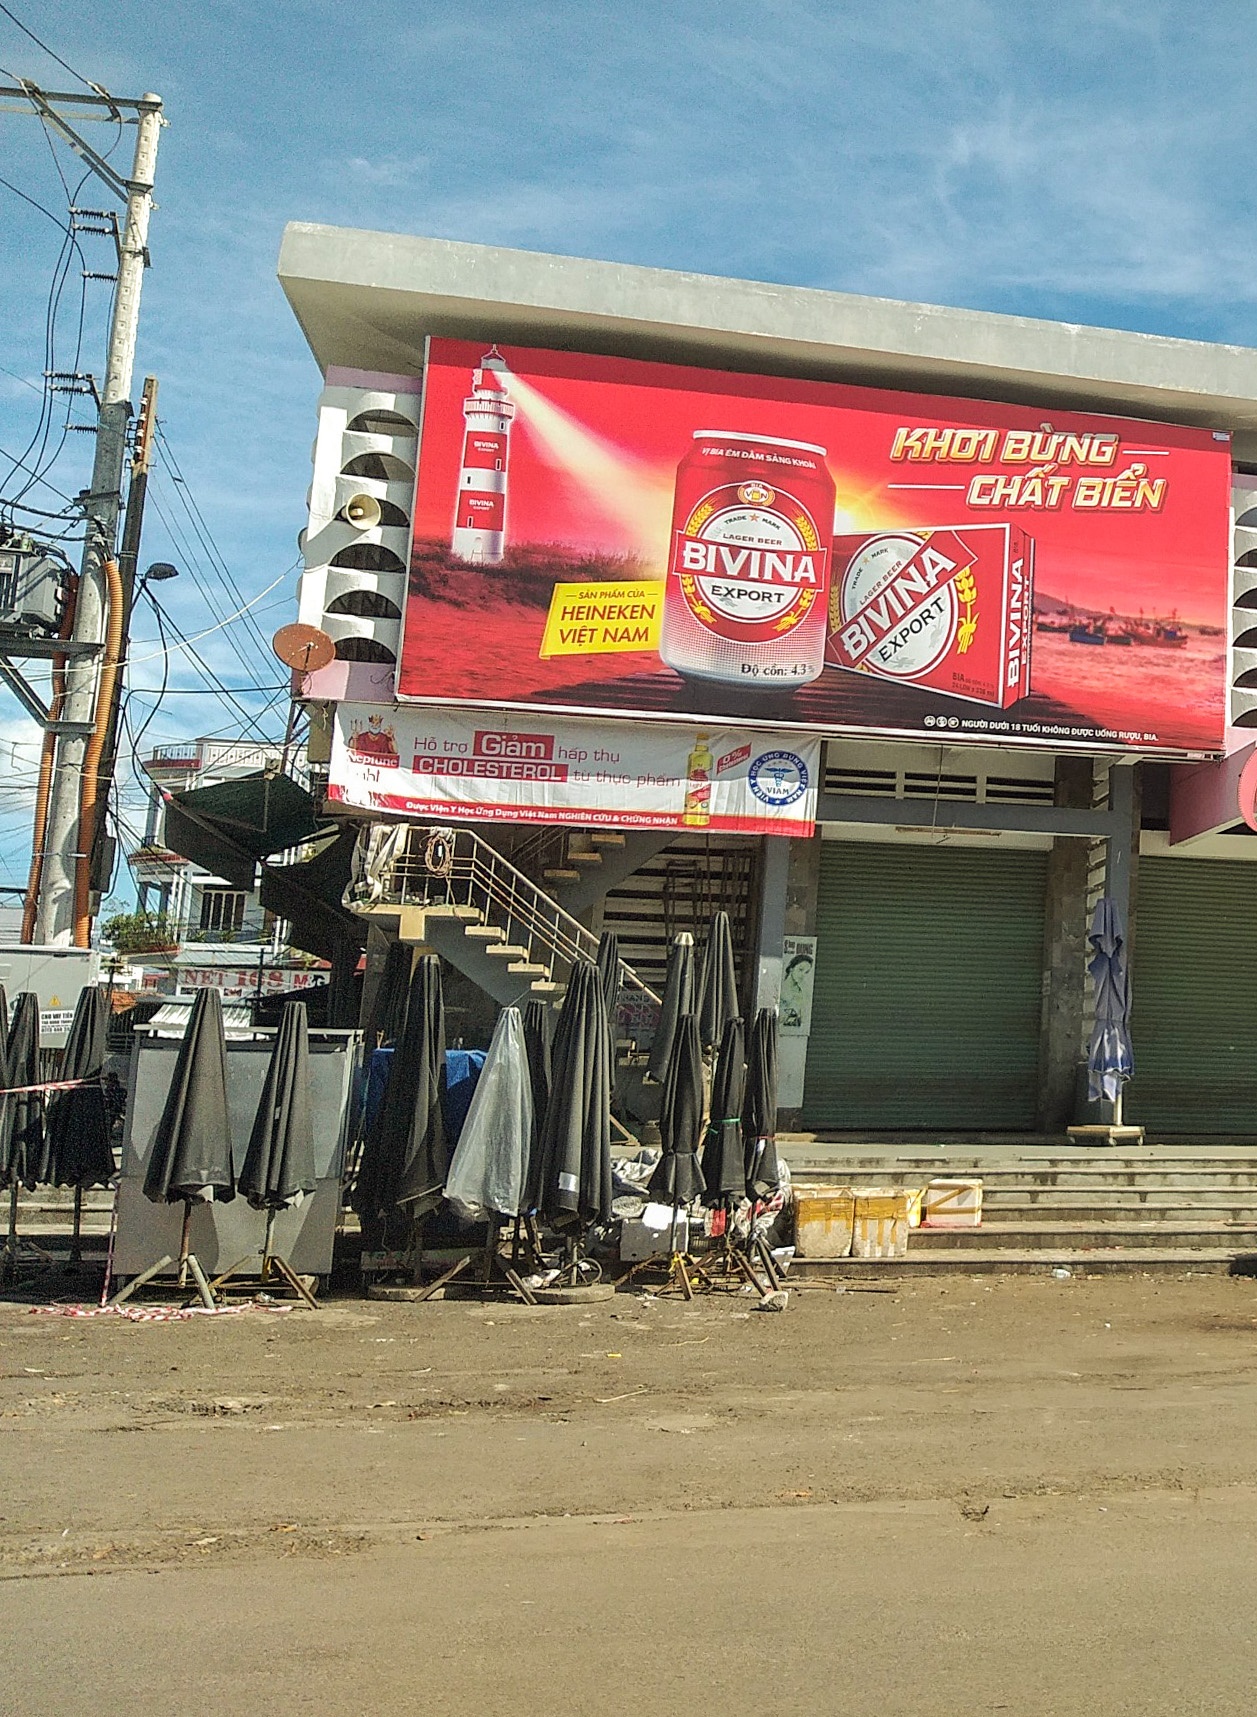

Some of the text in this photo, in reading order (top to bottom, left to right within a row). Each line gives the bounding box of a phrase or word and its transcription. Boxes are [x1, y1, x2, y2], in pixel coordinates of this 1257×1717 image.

[890, 423, 1119, 466] KHƠI BỪNG
[966, 463, 1168, 509] CHẤT BIỂN
[724, 515, 781, 530] TRADE MARK
[723, 533, 782, 546] LAGER BEER
[683, 541, 817, 583] BIVINA
[852, 568, 863, 590] TRADE
[860, 560, 903, 606] LAGER BEER
[711, 584, 785, 604] EXPORT
[840, 546, 957, 660] BIVINA
[561, 604, 656, 621] HEINEKEN
[1008, 558, 1024, 688] BIVINA
[560, 625, 649, 646] VIỆT NAM
[878, 597, 945, 663] EXPORT
[741, 663, 759, 676] Độ
[763, 663, 787, 676] cồn:
[961, 718, 988, 730] NGƯỜI
[989, 720, 1010, 731] DƯỚI
[1011, 722, 1021, 732] 18
[1022, 721, 1041, 732] TUỔI
[1042, 723, 1070, 735] KHÔNG
[1071, 726, 1095, 738] ĐƯỢC
[1096, 726, 1117, 739] UỐNG
[414, 734, 620, 763] Hỗ trợ Giảm hấp thụ
[418, 757, 681, 789] CHOLESTEROL từ thực phẩm
[766, 786, 790, 796] VIAM
[406, 801, 428, 812] Được
[430, 804, 449, 813] Viện
[458, 806, 476, 816] Học
[476, 806, 494, 817] Ứng
[496, 808, 518, 818] Dụng
[520, 810, 536, 819] Việt
[538, 811, 557, 819] Nam
[558, 812, 592, 821] NGHIÊN
[593, 812, 612, 822] CỨU
[612, 814, 619, 822] &
[621, 812, 652, 824] CHỨNG
[652, 816, 678, 826] NHẬN
[184, 968, 228, 986] NET
